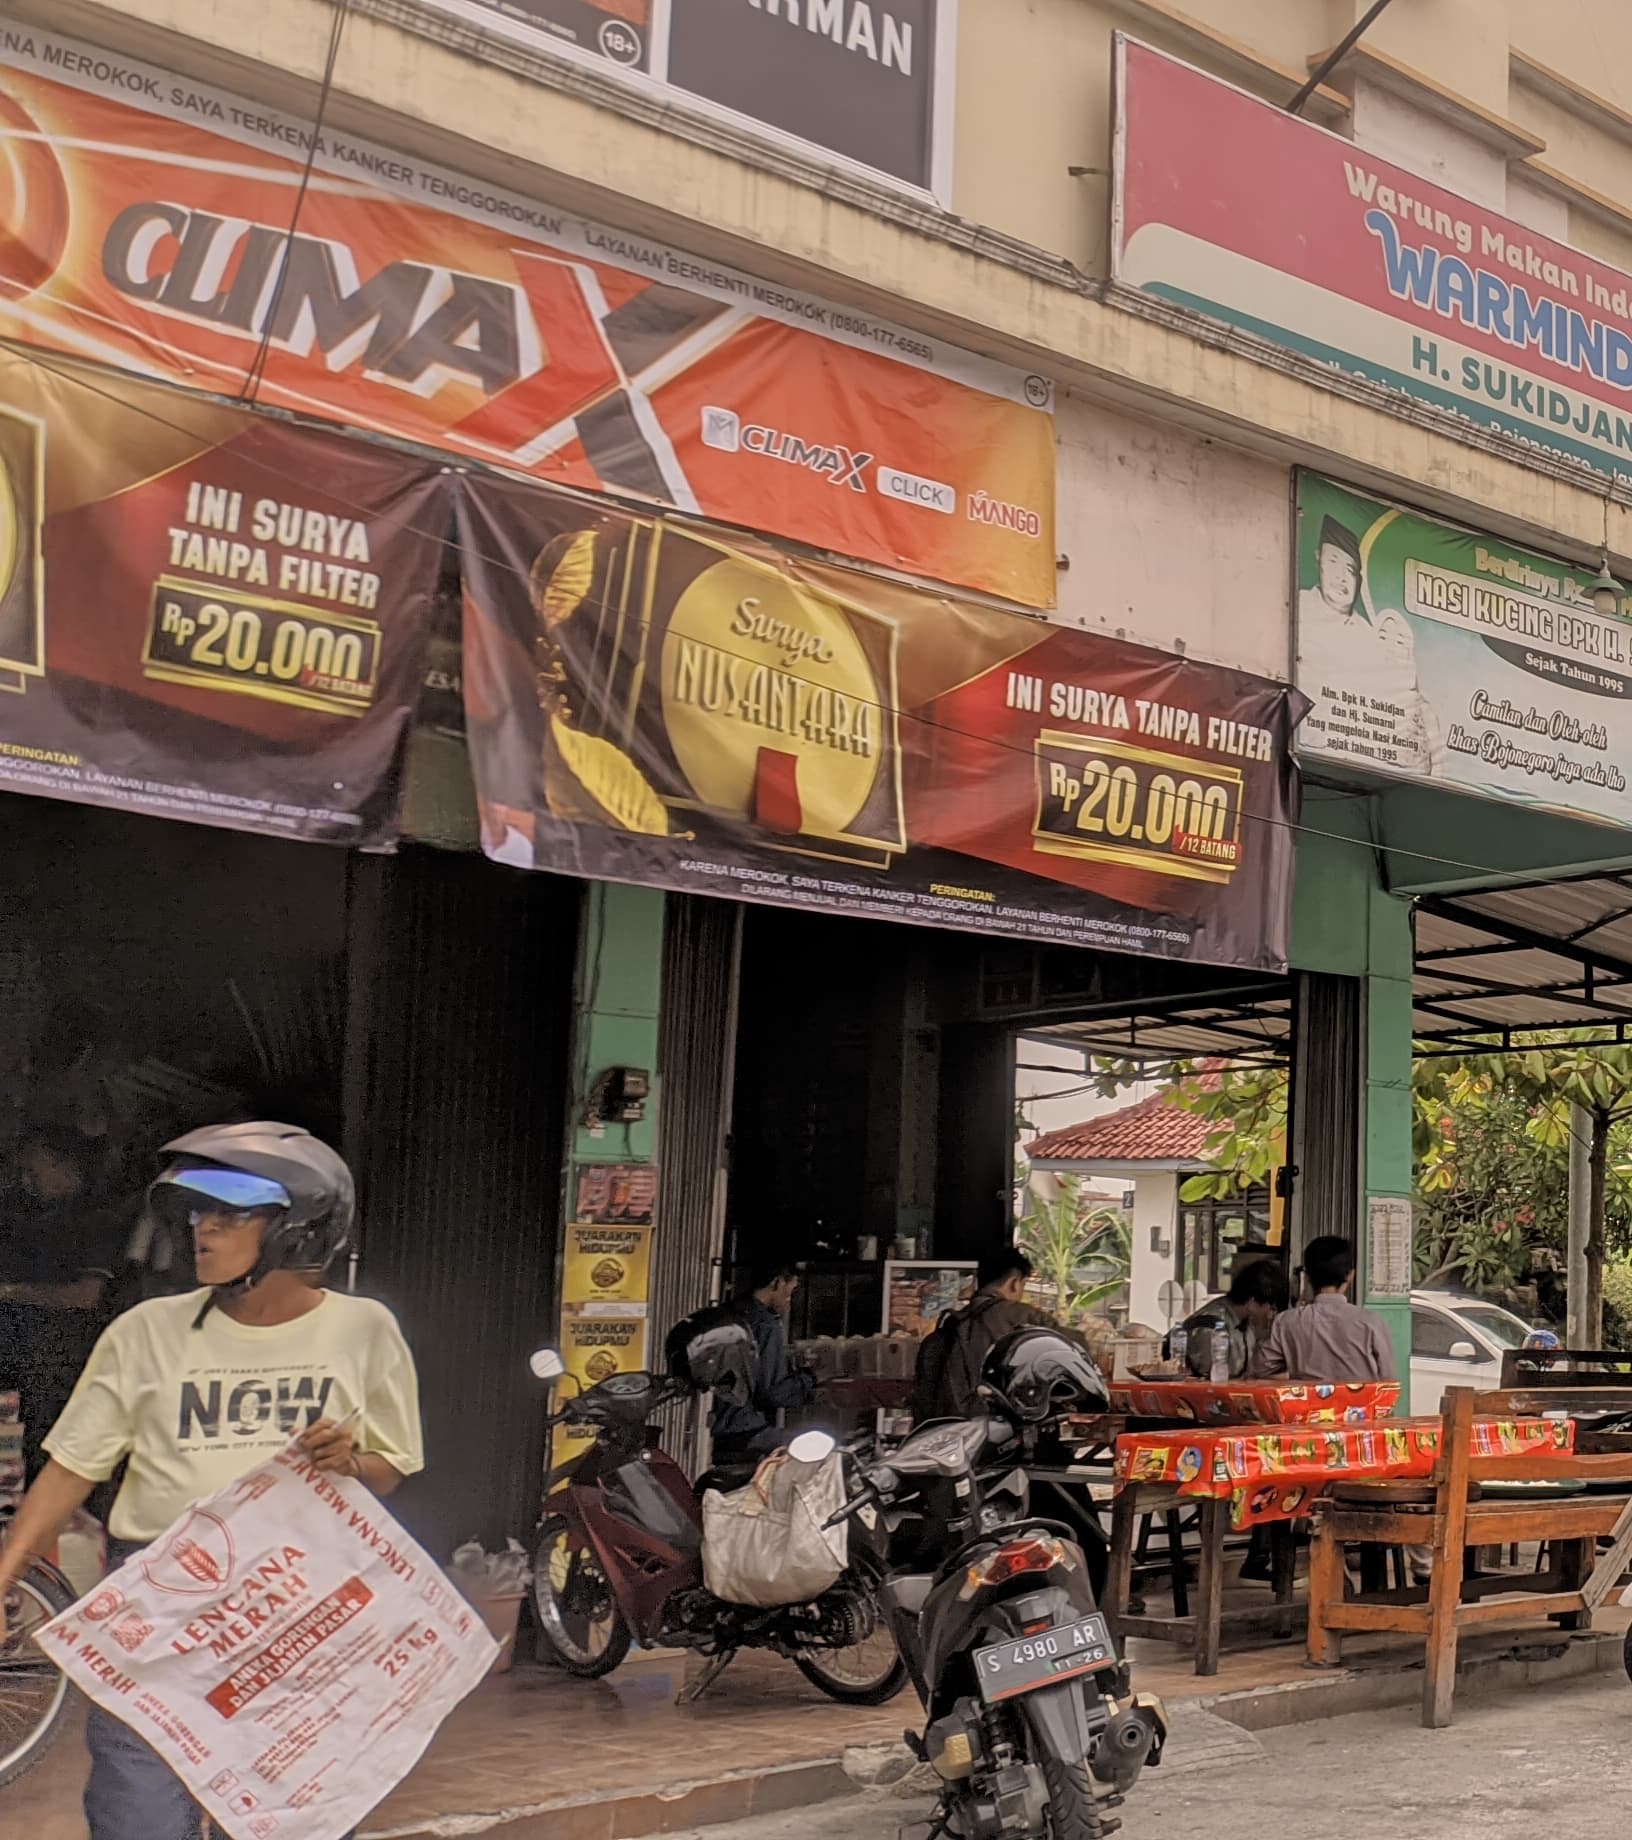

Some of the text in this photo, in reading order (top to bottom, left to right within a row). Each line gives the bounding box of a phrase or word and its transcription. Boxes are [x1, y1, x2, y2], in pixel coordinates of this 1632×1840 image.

[603, 31, 637, 54] 18+
[747, 0, 913, 77] MAN
[0, 30, 37, 58] NA
[43, 44, 164, 102] MEROKOK,
[170, 88, 225, 121] SAYA
[229, 106, 327, 154] TERKENA
[332, 142, 414, 186] KANKER
[418, 172, 563, 235] TENGGOROKAN
[585, 229, 663, 270] LAYANAN
[667, 259, 750, 297] BERHENTI
[753, 286, 827, 324] MEROKOK
[1343, 161, 1473, 251] Warung
[1481, 224, 1580, 297] Makan
[101, 200, 760, 516] CLIMAX
[1412, 335, 1451, 382] H.
[742, 425, 1041, 537] CLIMAX CLICK MANGO
[185, 482, 371, 563] INI SURYA
[167, 528, 381, 609] TANPA FILTER
[731, 597, 834, 668] Surya
[1417, 572, 1469, 617] NASI
[1475, 588, 1554, 641] KUCING
[1558, 614, 1600, 656] BPK
[1604, 628, 1625, 663] H.
[676, 639, 872, 758] NUSANTARA
[1321, 686, 1405, 717] Alm. Bpk H. Sukidjan
[1525, 652, 1625, 693] Sejak Tahun 1995
[1006, 672, 1274, 762] INI SURYA TANPA FILTER
[1307, 715, 1326, 732] Yang
[1328, 721, 1370, 740] mengelola
[1372, 730, 1390, 744] Nasi
[1331, 704, 1347, 717] dan
[1362, 712, 1396, 730] Sumarni
[1470, 689, 1523, 729] Camilan
[1523, 706, 1548, 735] dan
[1327, 737, 1398, 761] sejak tahun 1995
[1447, 723, 1626, 792] khas Bojonegoro juga ada lho
[1200, 840, 1237, 860] BATANG
[680, 859, 729, 876] KARENA
[791, 875, 821, 891] SAYA
[822, 880, 871, 896] TERKENA
[872, 887, 916, 903] KANKER
[995, 906, 1037, 921] LAYANAN
[1039, 912, 1084, 928] BERHENTI
[1084, 919, 1128, 934] MEROKOK
[929, 883, 997, 903] PERINGATAN:
[570, 1323, 637, 1335] JUARAKAN
[575, 1335, 630, 1347] HIDUPMU
[177, 1376, 335, 1439] NOW
[294, 1460, 349, 1516] MERAH
[347, 1511, 416, 1582] LENCANA
[171, 1545, 307, 1656] LENCANA
[208, 1573, 308, 1659] MERAH
[269, 1596, 342, 1658] GORENGAN
[77, 1643, 137, 1695] MERAH
[229, 1680, 260, 1709] DAN
[315, 1597, 364, 1639] PASAR
[383, 1651, 410, 1678] 25
[407, 1627, 439, 1650] kg
[987, 1625, 1097, 1672] S 4980 AR
